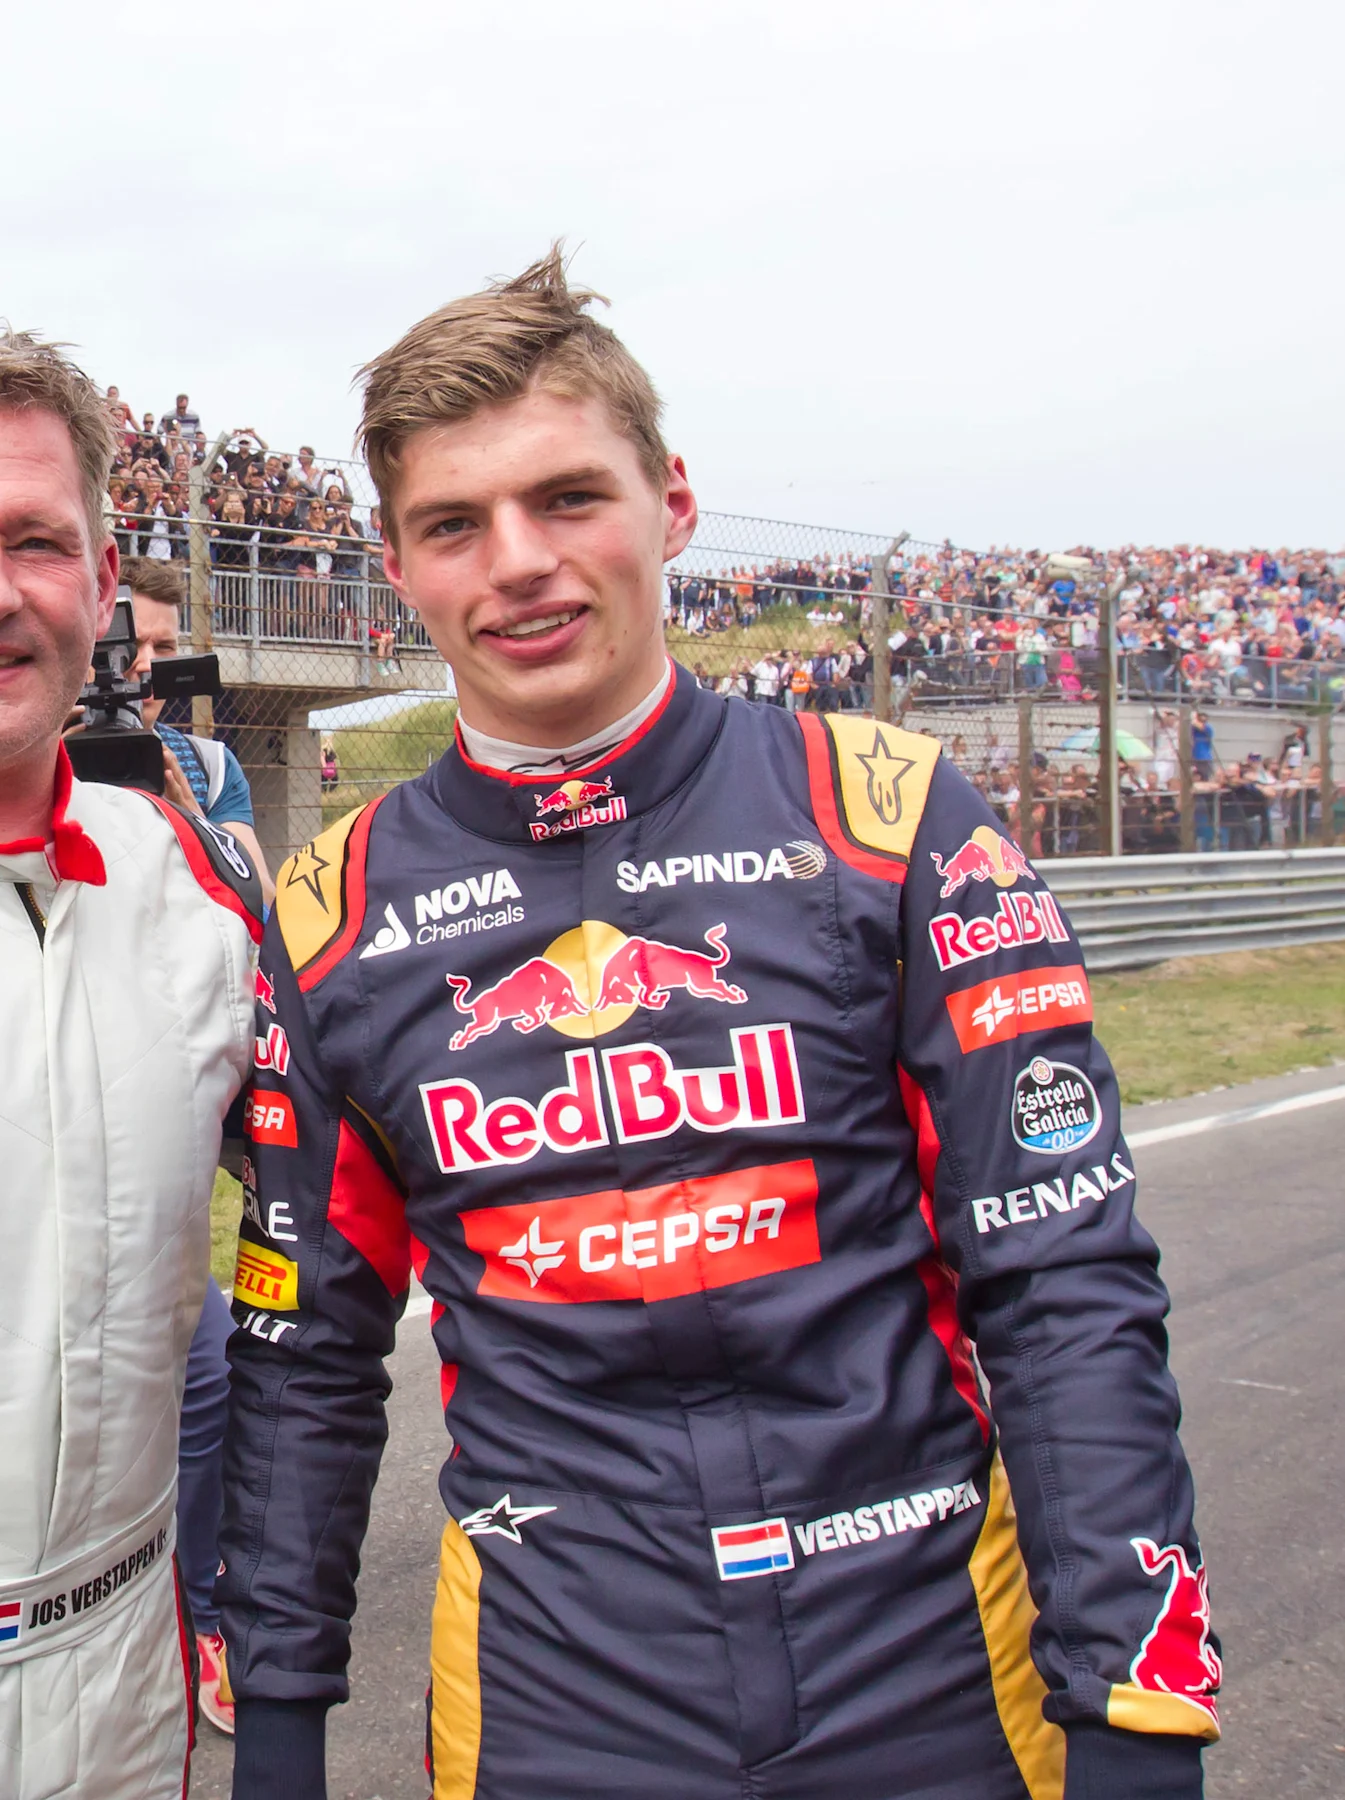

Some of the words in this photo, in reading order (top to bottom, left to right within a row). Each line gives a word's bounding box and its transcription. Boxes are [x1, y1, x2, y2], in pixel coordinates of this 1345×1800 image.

[617, 848, 795, 893] SAPINDA
[414, 868, 523, 926] NOVA
[416, 904, 525, 946] Chemicals
[1016, 981, 1086, 1016] EPSA
[254, 1023, 291, 1077] ull
[418, 1046, 610, 1175] Red
[601, 1023, 806, 1145] Bull
[1017, 1080, 1085, 1113] Estrella
[1023, 1102, 1089, 1136] Galicia
[578, 1197, 787, 1274] CEPSA
[235, 1266, 283, 1302] ELLI
[794, 1477, 982, 1556] VERSTAPPEN
[29, 1593, 67, 1629] JOS
[71, 1539, 156, 1615] VERSTAPPEN
